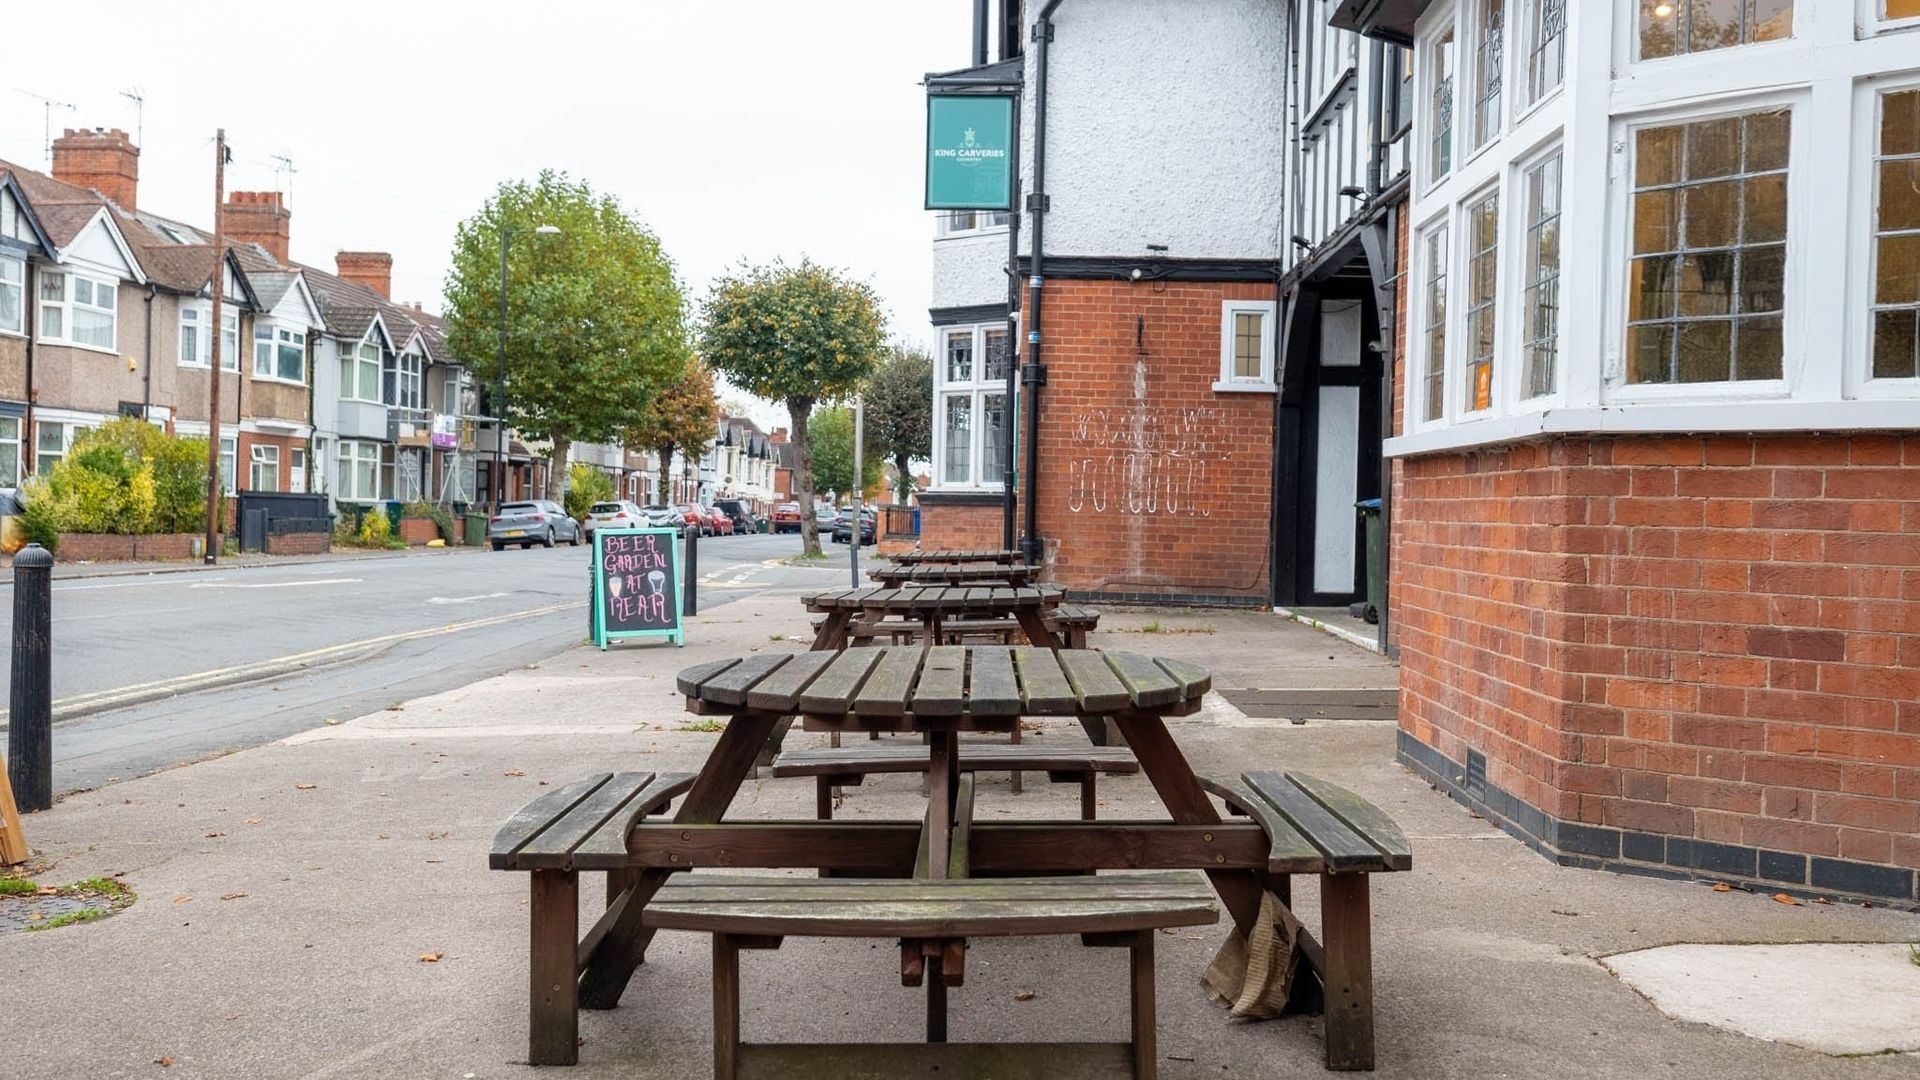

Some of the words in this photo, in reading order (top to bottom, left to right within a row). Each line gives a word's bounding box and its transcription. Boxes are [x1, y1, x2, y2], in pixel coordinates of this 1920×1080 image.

[935, 149, 956, 157] KING
[958, 149, 1004, 157] CARVERIES
[605, 535, 658, 554] BEER
[604, 554, 667, 575] GARDEN
[626, 573, 646, 594] AT
[609, 593, 672, 623] REAR
